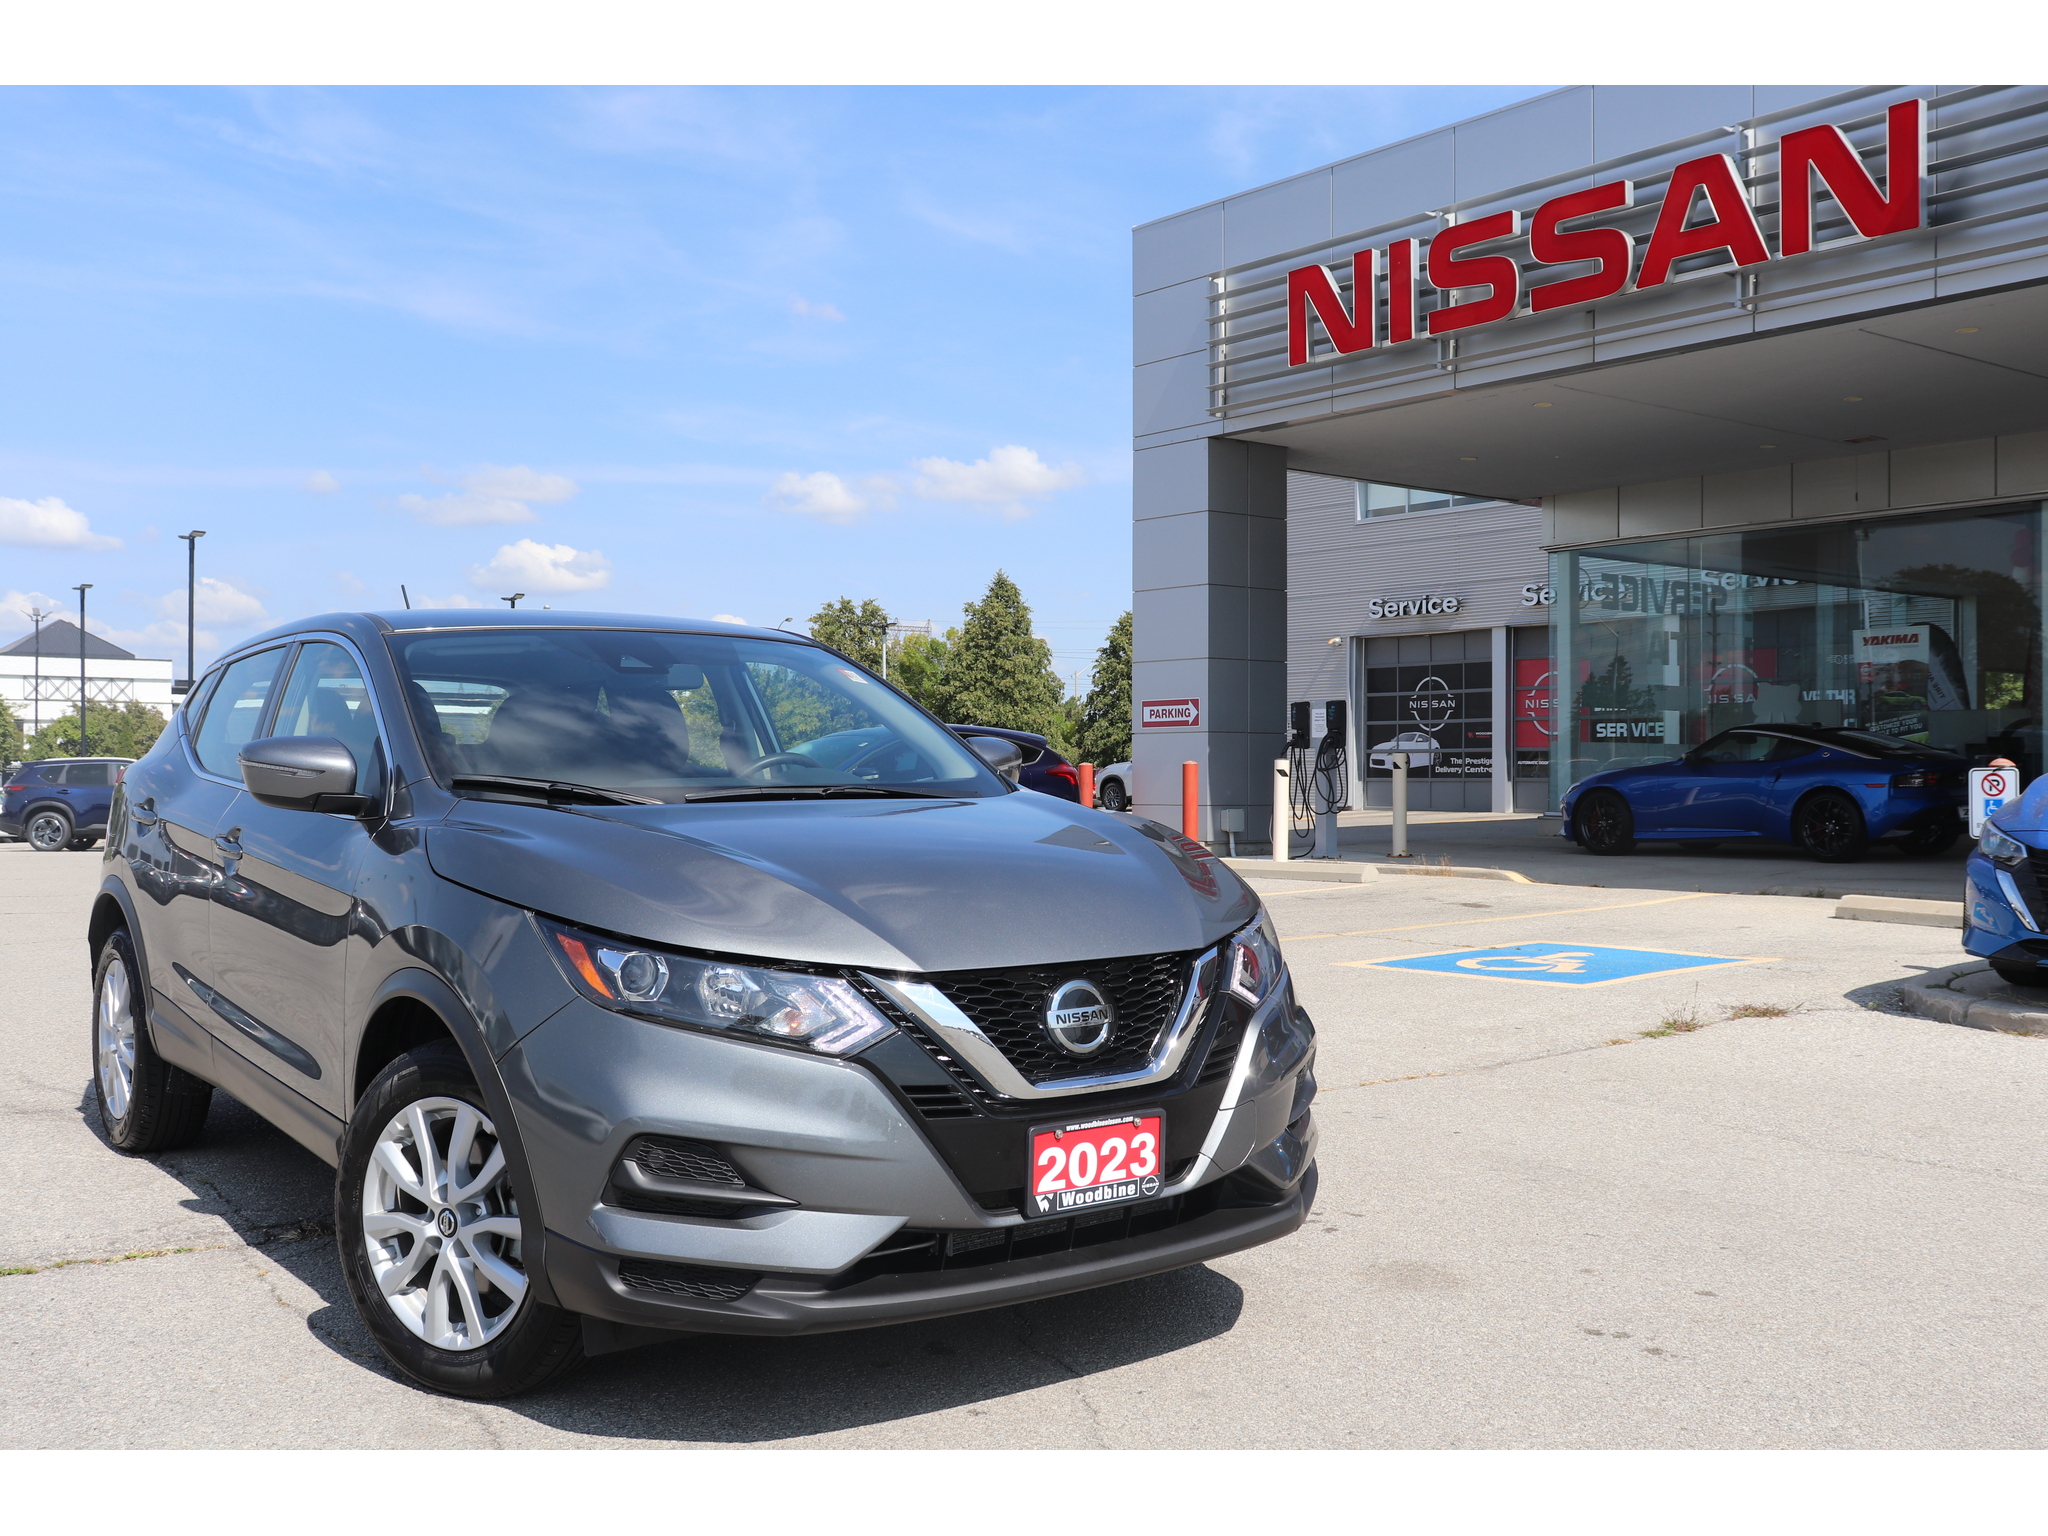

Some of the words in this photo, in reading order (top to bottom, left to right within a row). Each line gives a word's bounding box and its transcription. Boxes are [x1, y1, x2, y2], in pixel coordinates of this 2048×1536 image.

[1287, 98, 1927, 367] NISSAN
[1368, 595, 1459, 619] Service
[1862, 633, 1920, 647] YAKIMA
[1409, 700, 1456, 709] NISSAN
[1149, 707, 1191, 719] PARKING
[1450, 757, 1463, 765] The
[1435, 766, 1462, 774] Delivery
[1055, 1009, 1109, 1026] NISSAN
[1066, 1116, 1134, 1132] www.woodbinenissan.com
[1037, 1132, 1156, 1193] 2023
[1141, 1181, 1159, 1190] NISSAN
[1061, 1181, 1136, 1207] Woodbine
